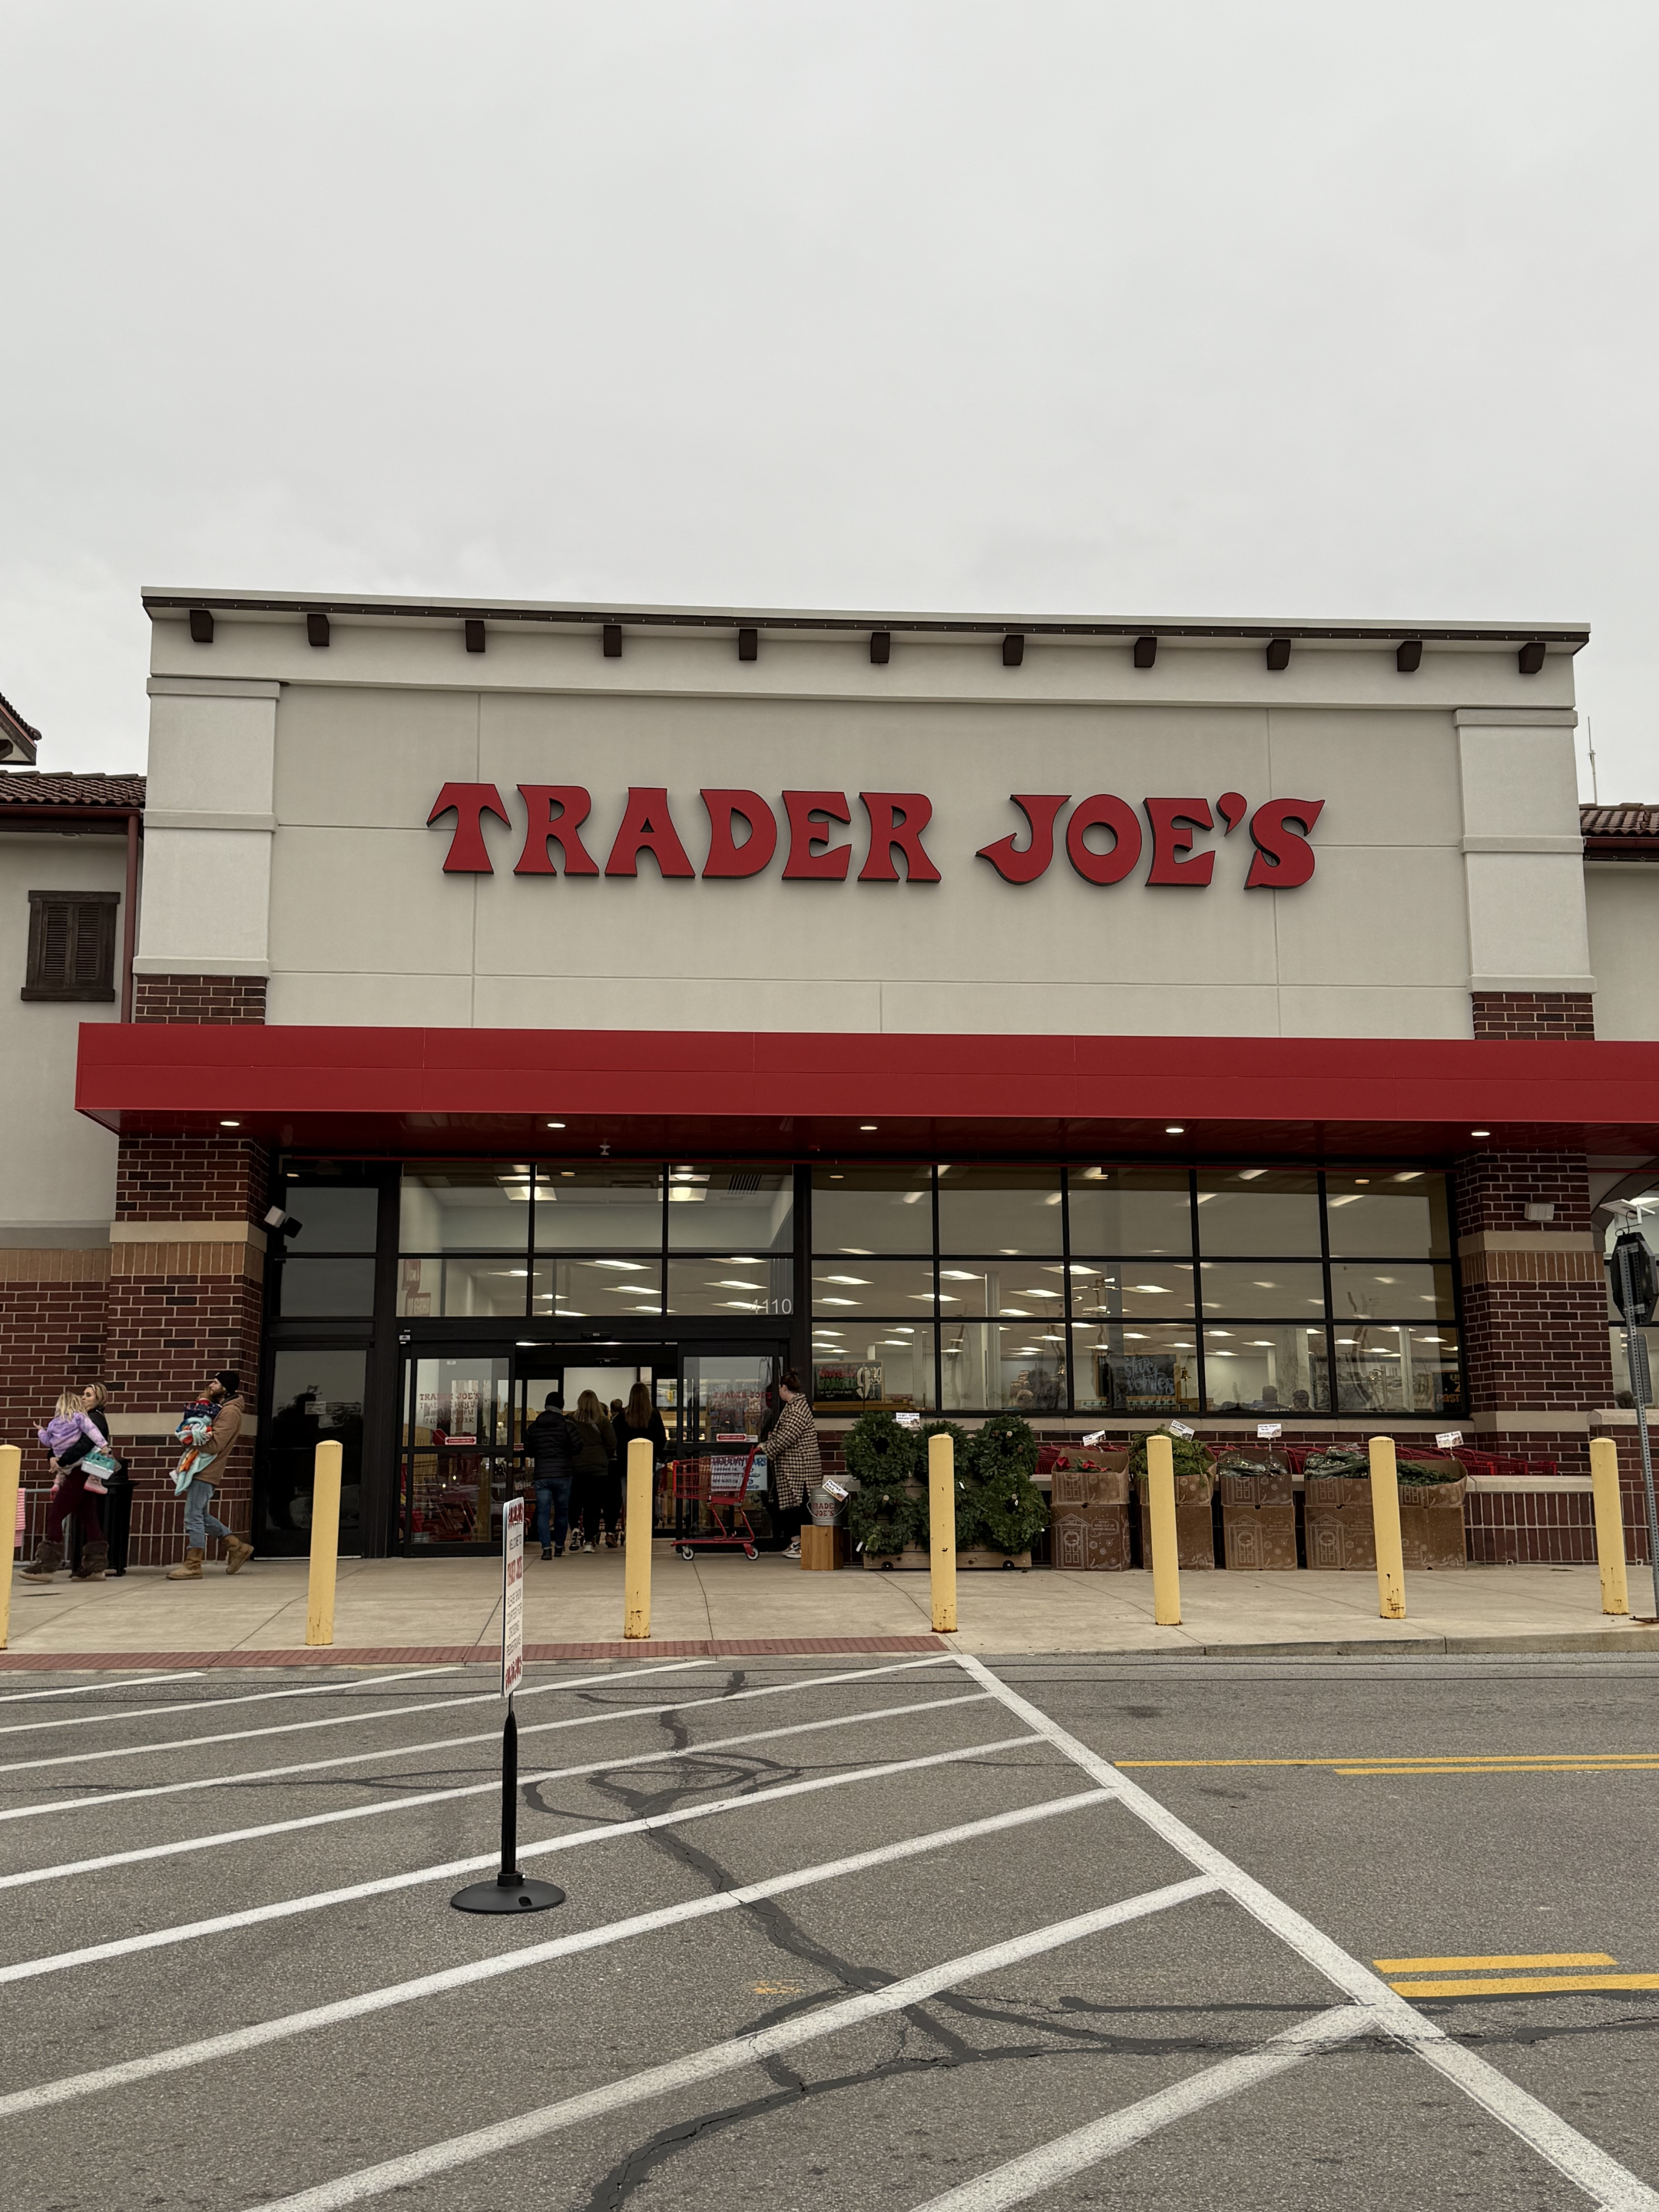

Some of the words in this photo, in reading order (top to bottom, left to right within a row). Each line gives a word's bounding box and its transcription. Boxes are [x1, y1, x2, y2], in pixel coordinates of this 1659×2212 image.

[426, 782, 941, 883] TRADER
[976, 791, 1326, 890] JOE'S
[750, 1298, 792, 1315] 4110
